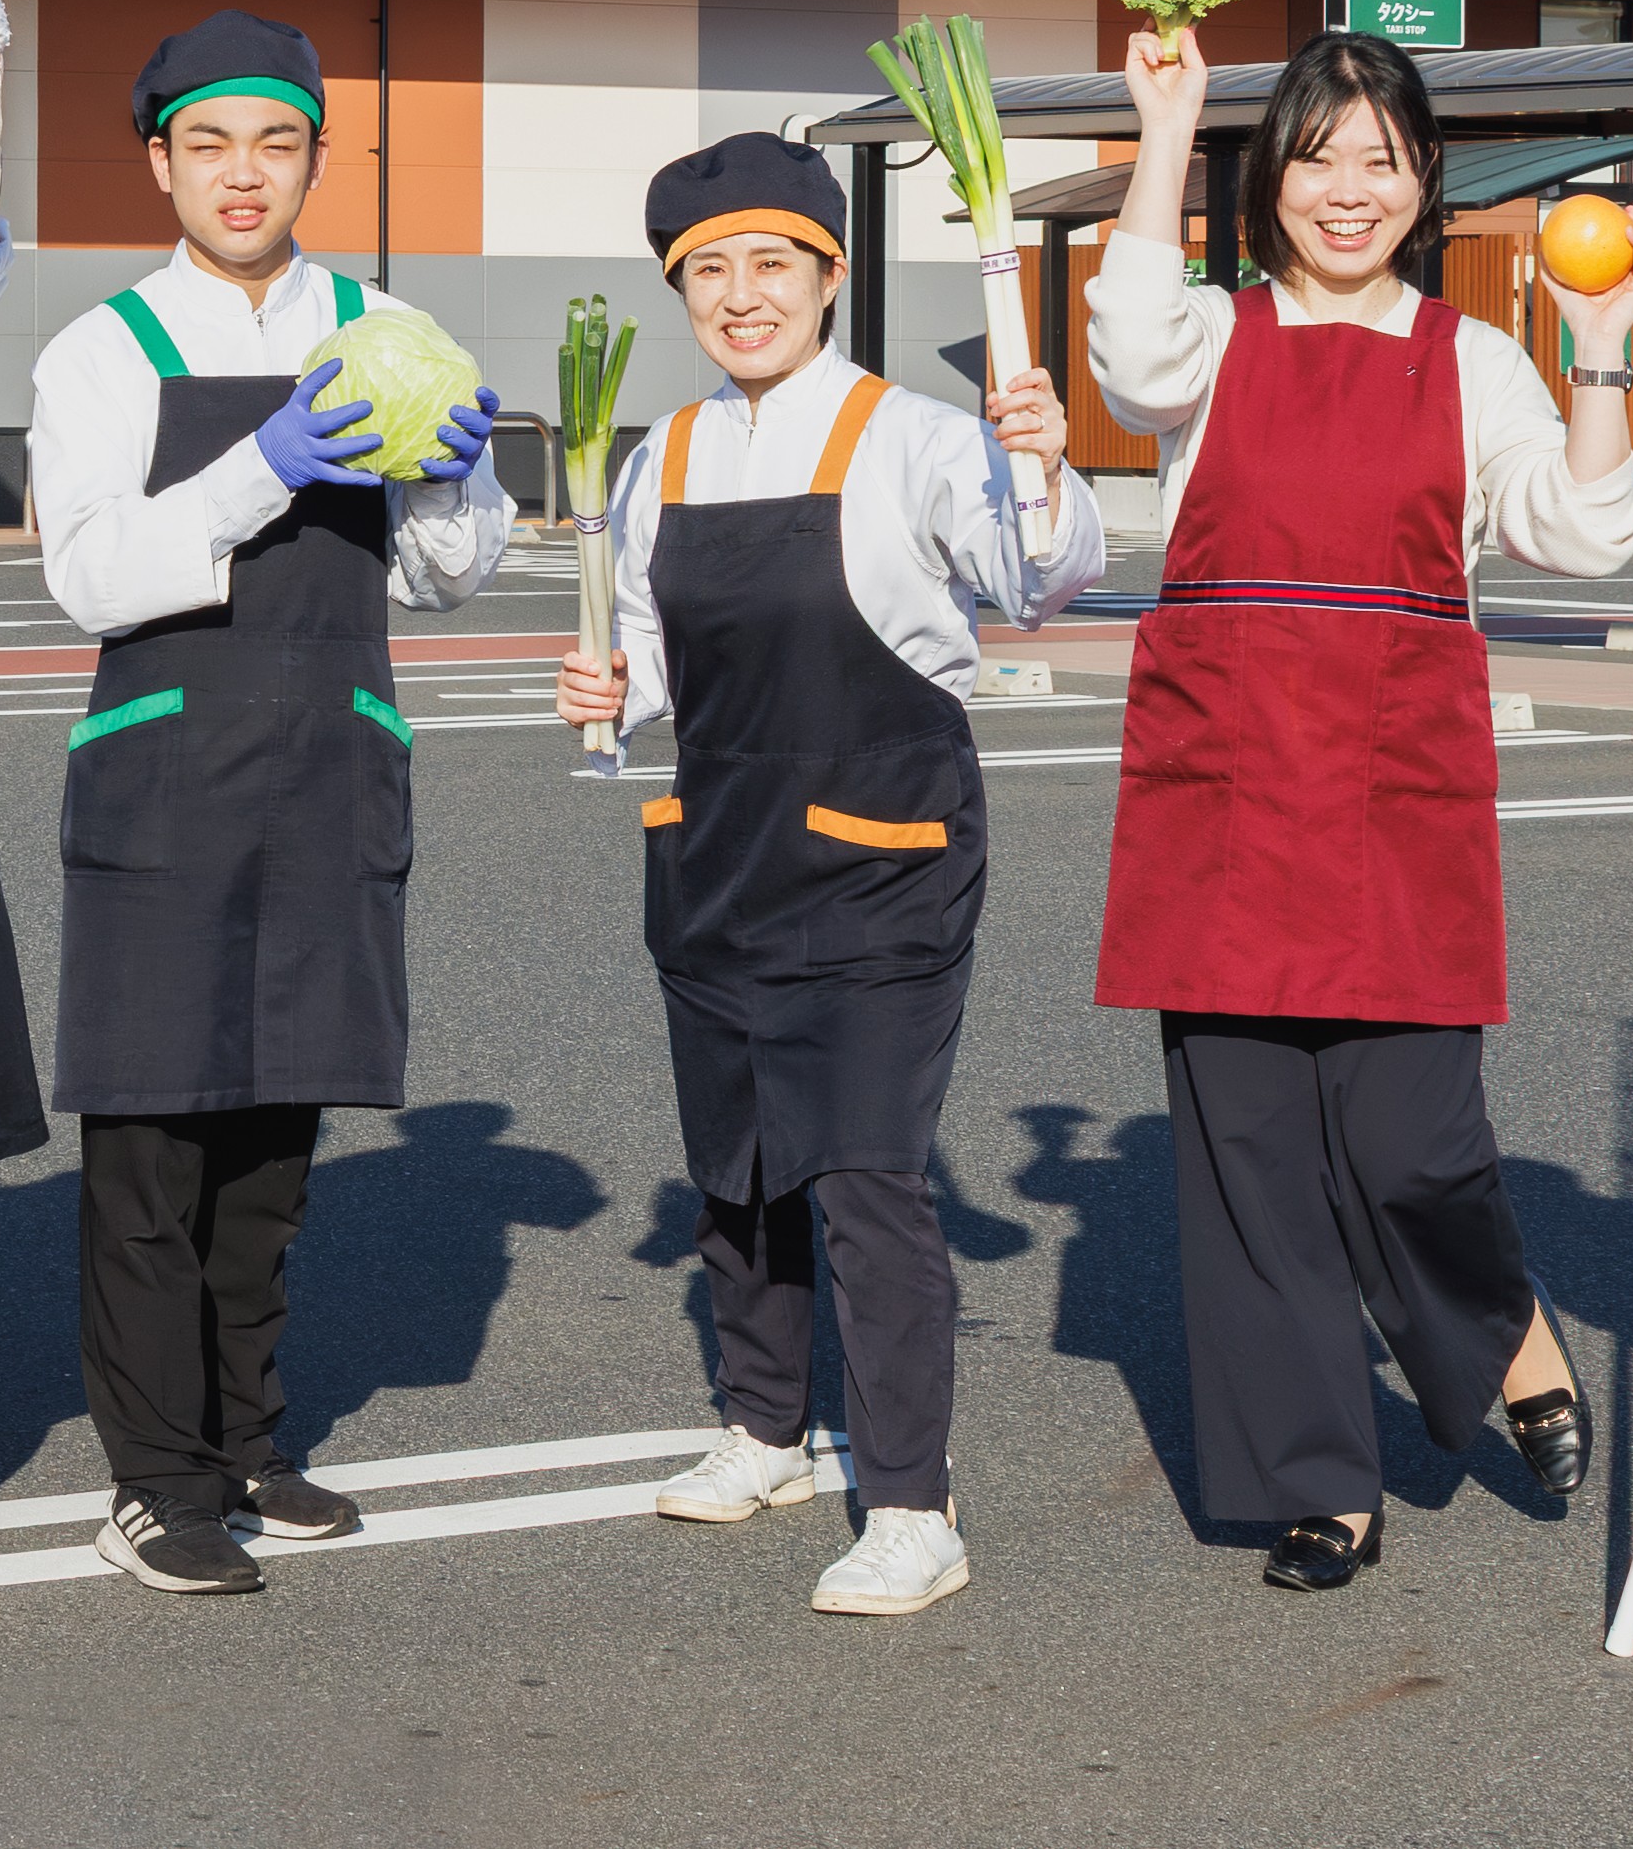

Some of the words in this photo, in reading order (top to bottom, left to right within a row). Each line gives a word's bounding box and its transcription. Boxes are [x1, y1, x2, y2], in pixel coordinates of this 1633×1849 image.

[1377, 2, 1435, 22] タクシー
[1385, 24, 1404, 34] TAXI
[1405, 25, 1426, 35] STOP
